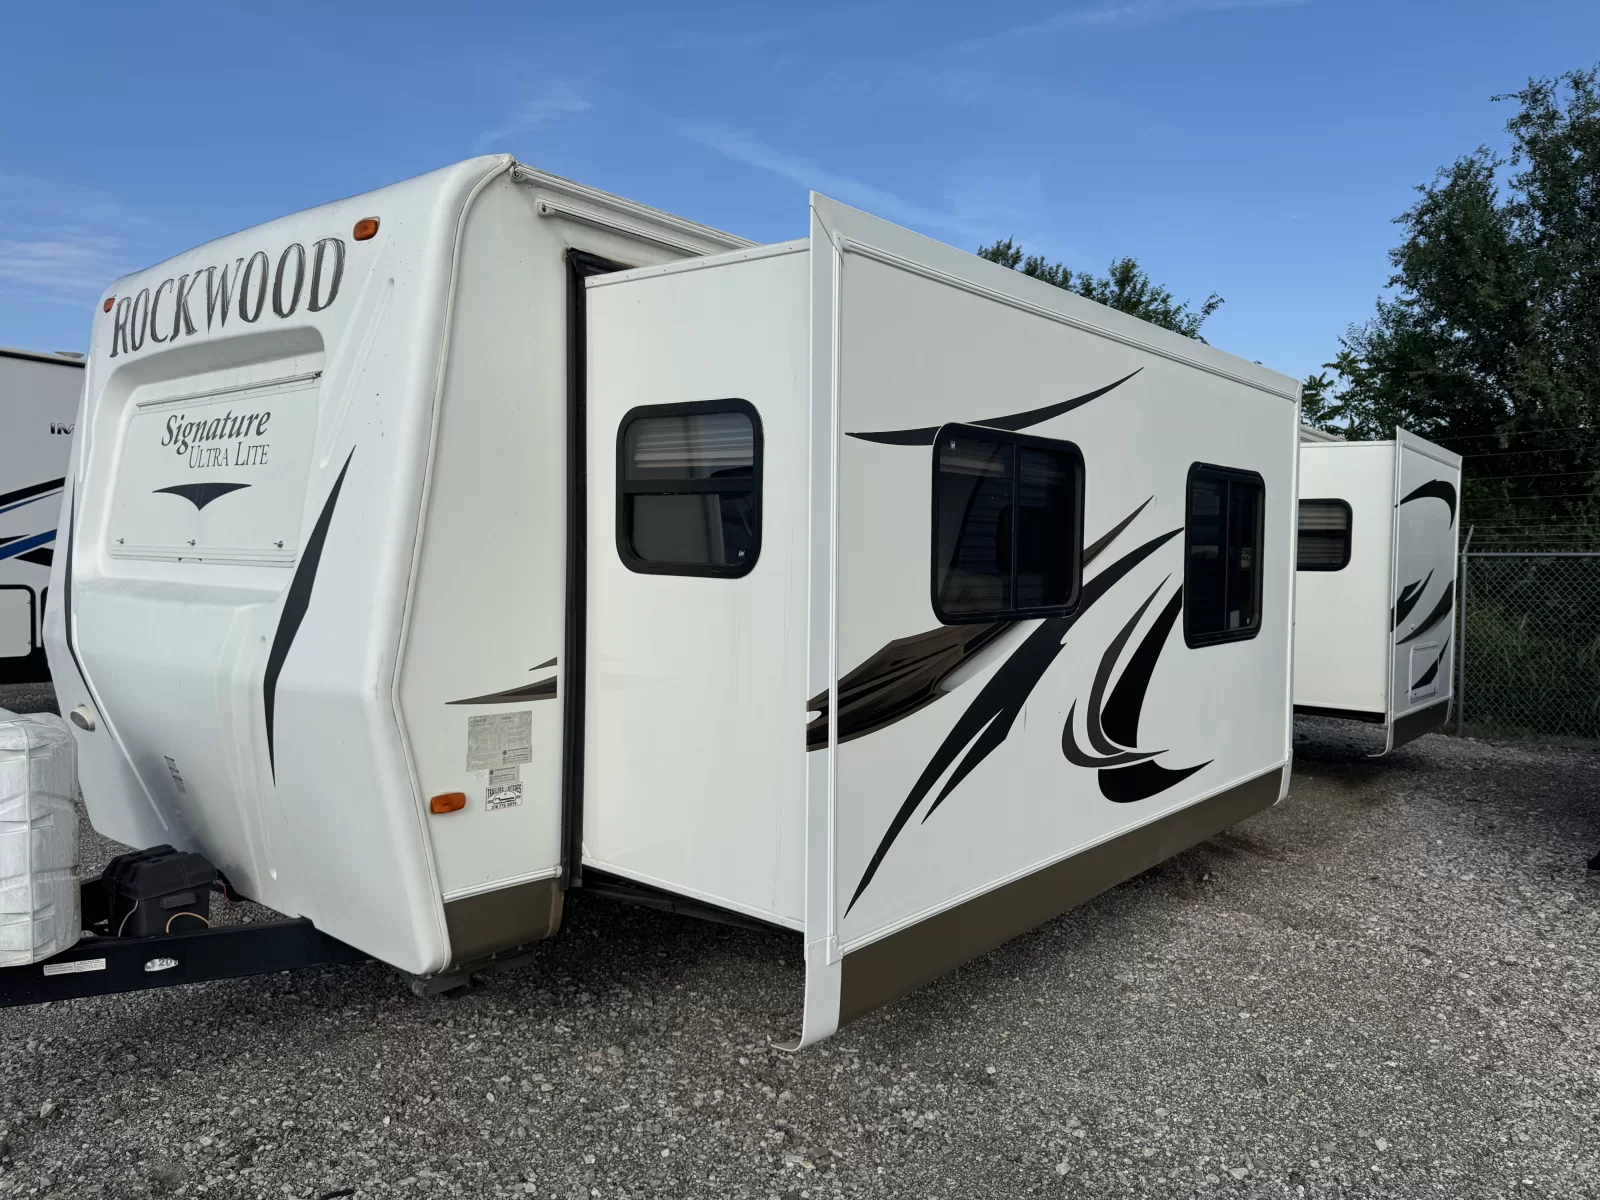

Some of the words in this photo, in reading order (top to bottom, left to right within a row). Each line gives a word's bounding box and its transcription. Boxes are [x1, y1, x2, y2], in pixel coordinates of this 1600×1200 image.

[109, 237, 346, 358] ROCKWOOD
[161, 409, 271, 455] Signature
[189, 445, 229, 469] ULTRA
[234, 441, 269, 467] LITE
